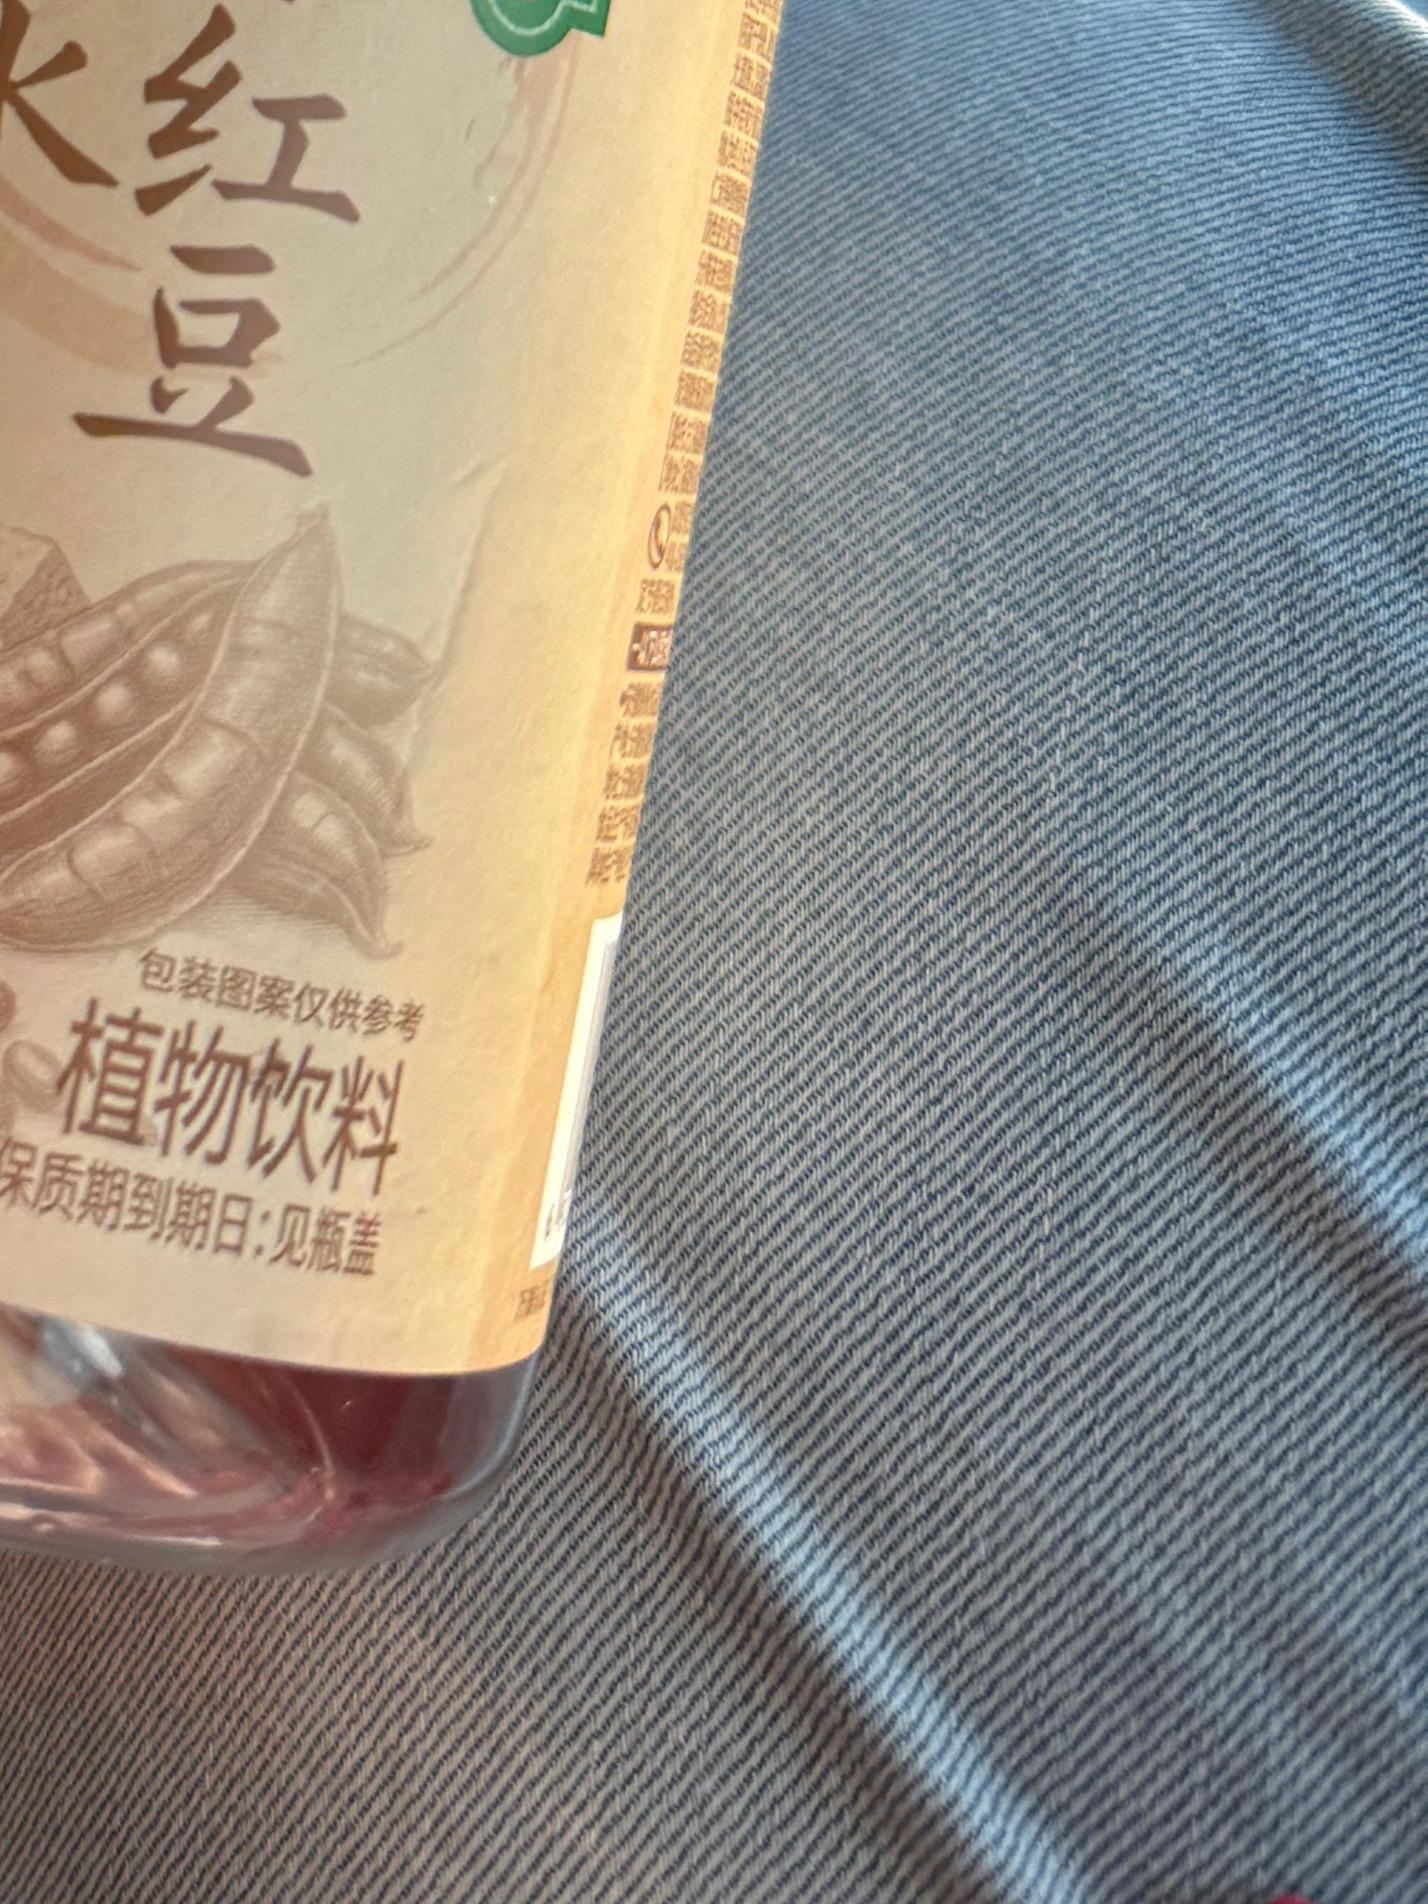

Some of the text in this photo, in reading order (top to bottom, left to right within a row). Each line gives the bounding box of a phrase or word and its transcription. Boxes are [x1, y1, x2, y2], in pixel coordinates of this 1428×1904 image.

[137, 948, 427, 1042] 包装图案仅供参考
[55, 997, 408, 1193] 植物饮料
